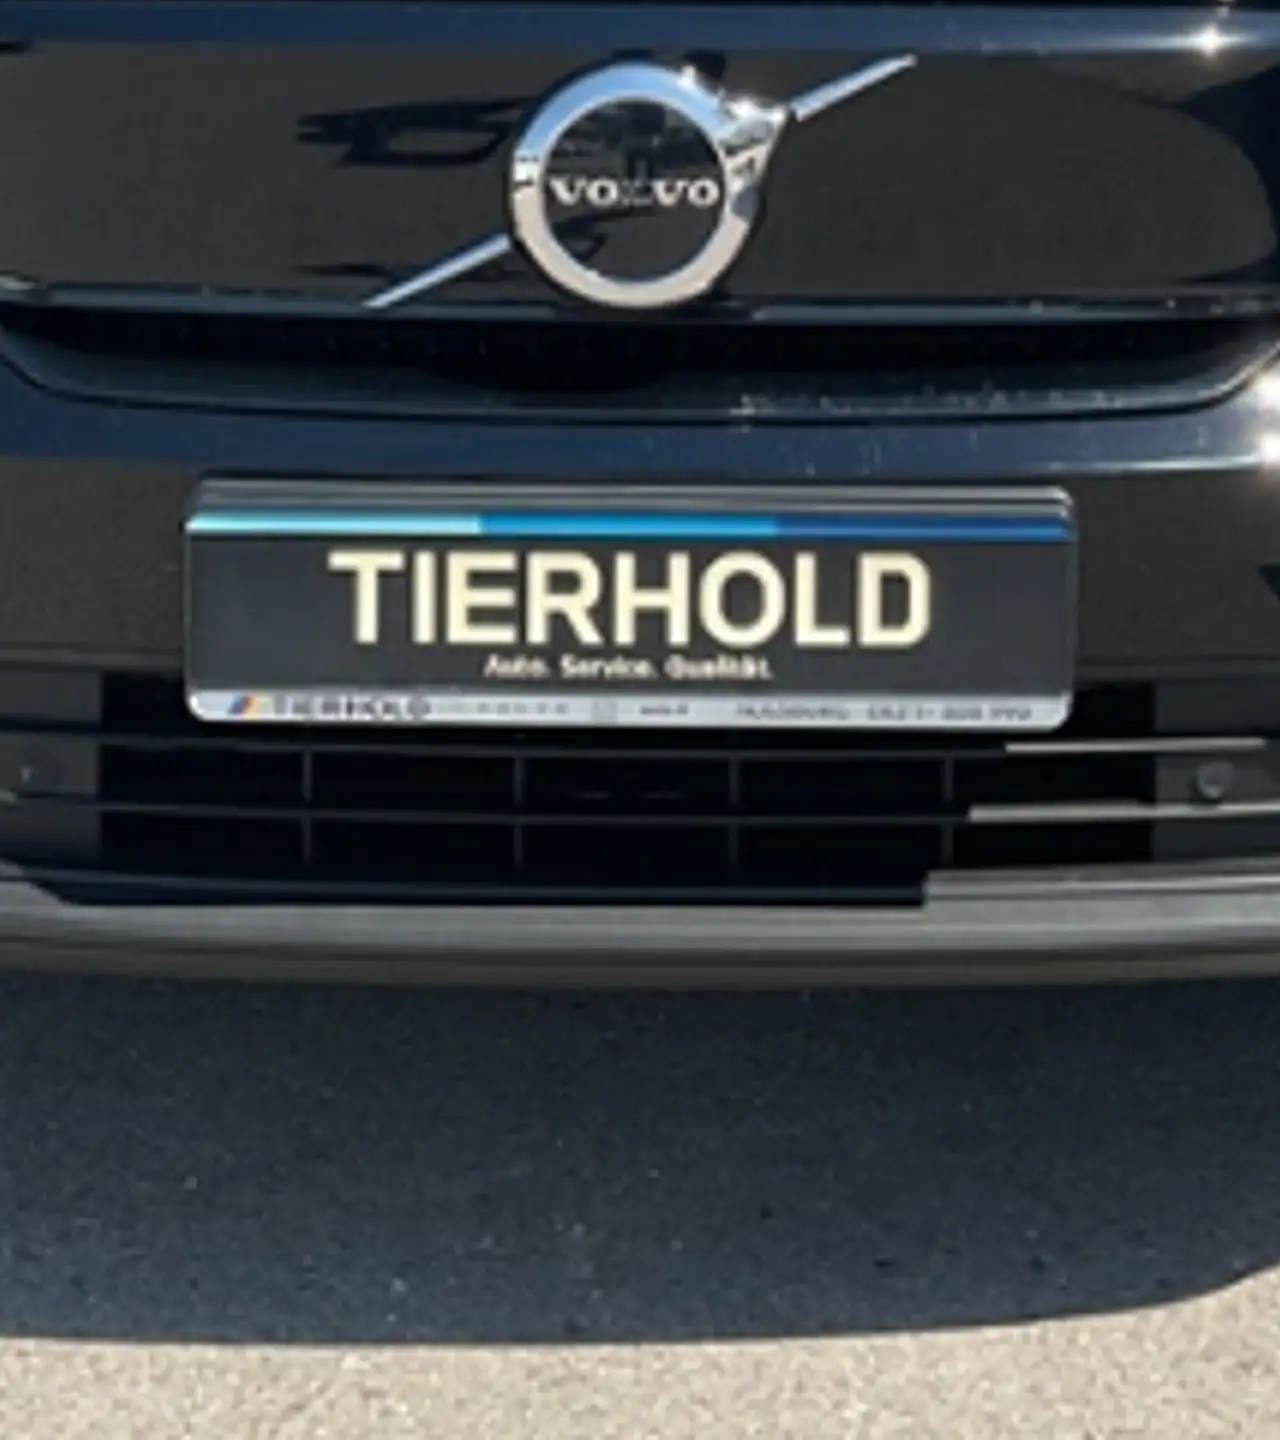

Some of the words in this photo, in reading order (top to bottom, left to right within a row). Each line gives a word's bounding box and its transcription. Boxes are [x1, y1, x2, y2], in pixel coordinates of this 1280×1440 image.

[549, 177, 721, 207] VOLVO
[328, 550, 932, 648] TIERHOLD
[560, 654, 658, 678] Service.
